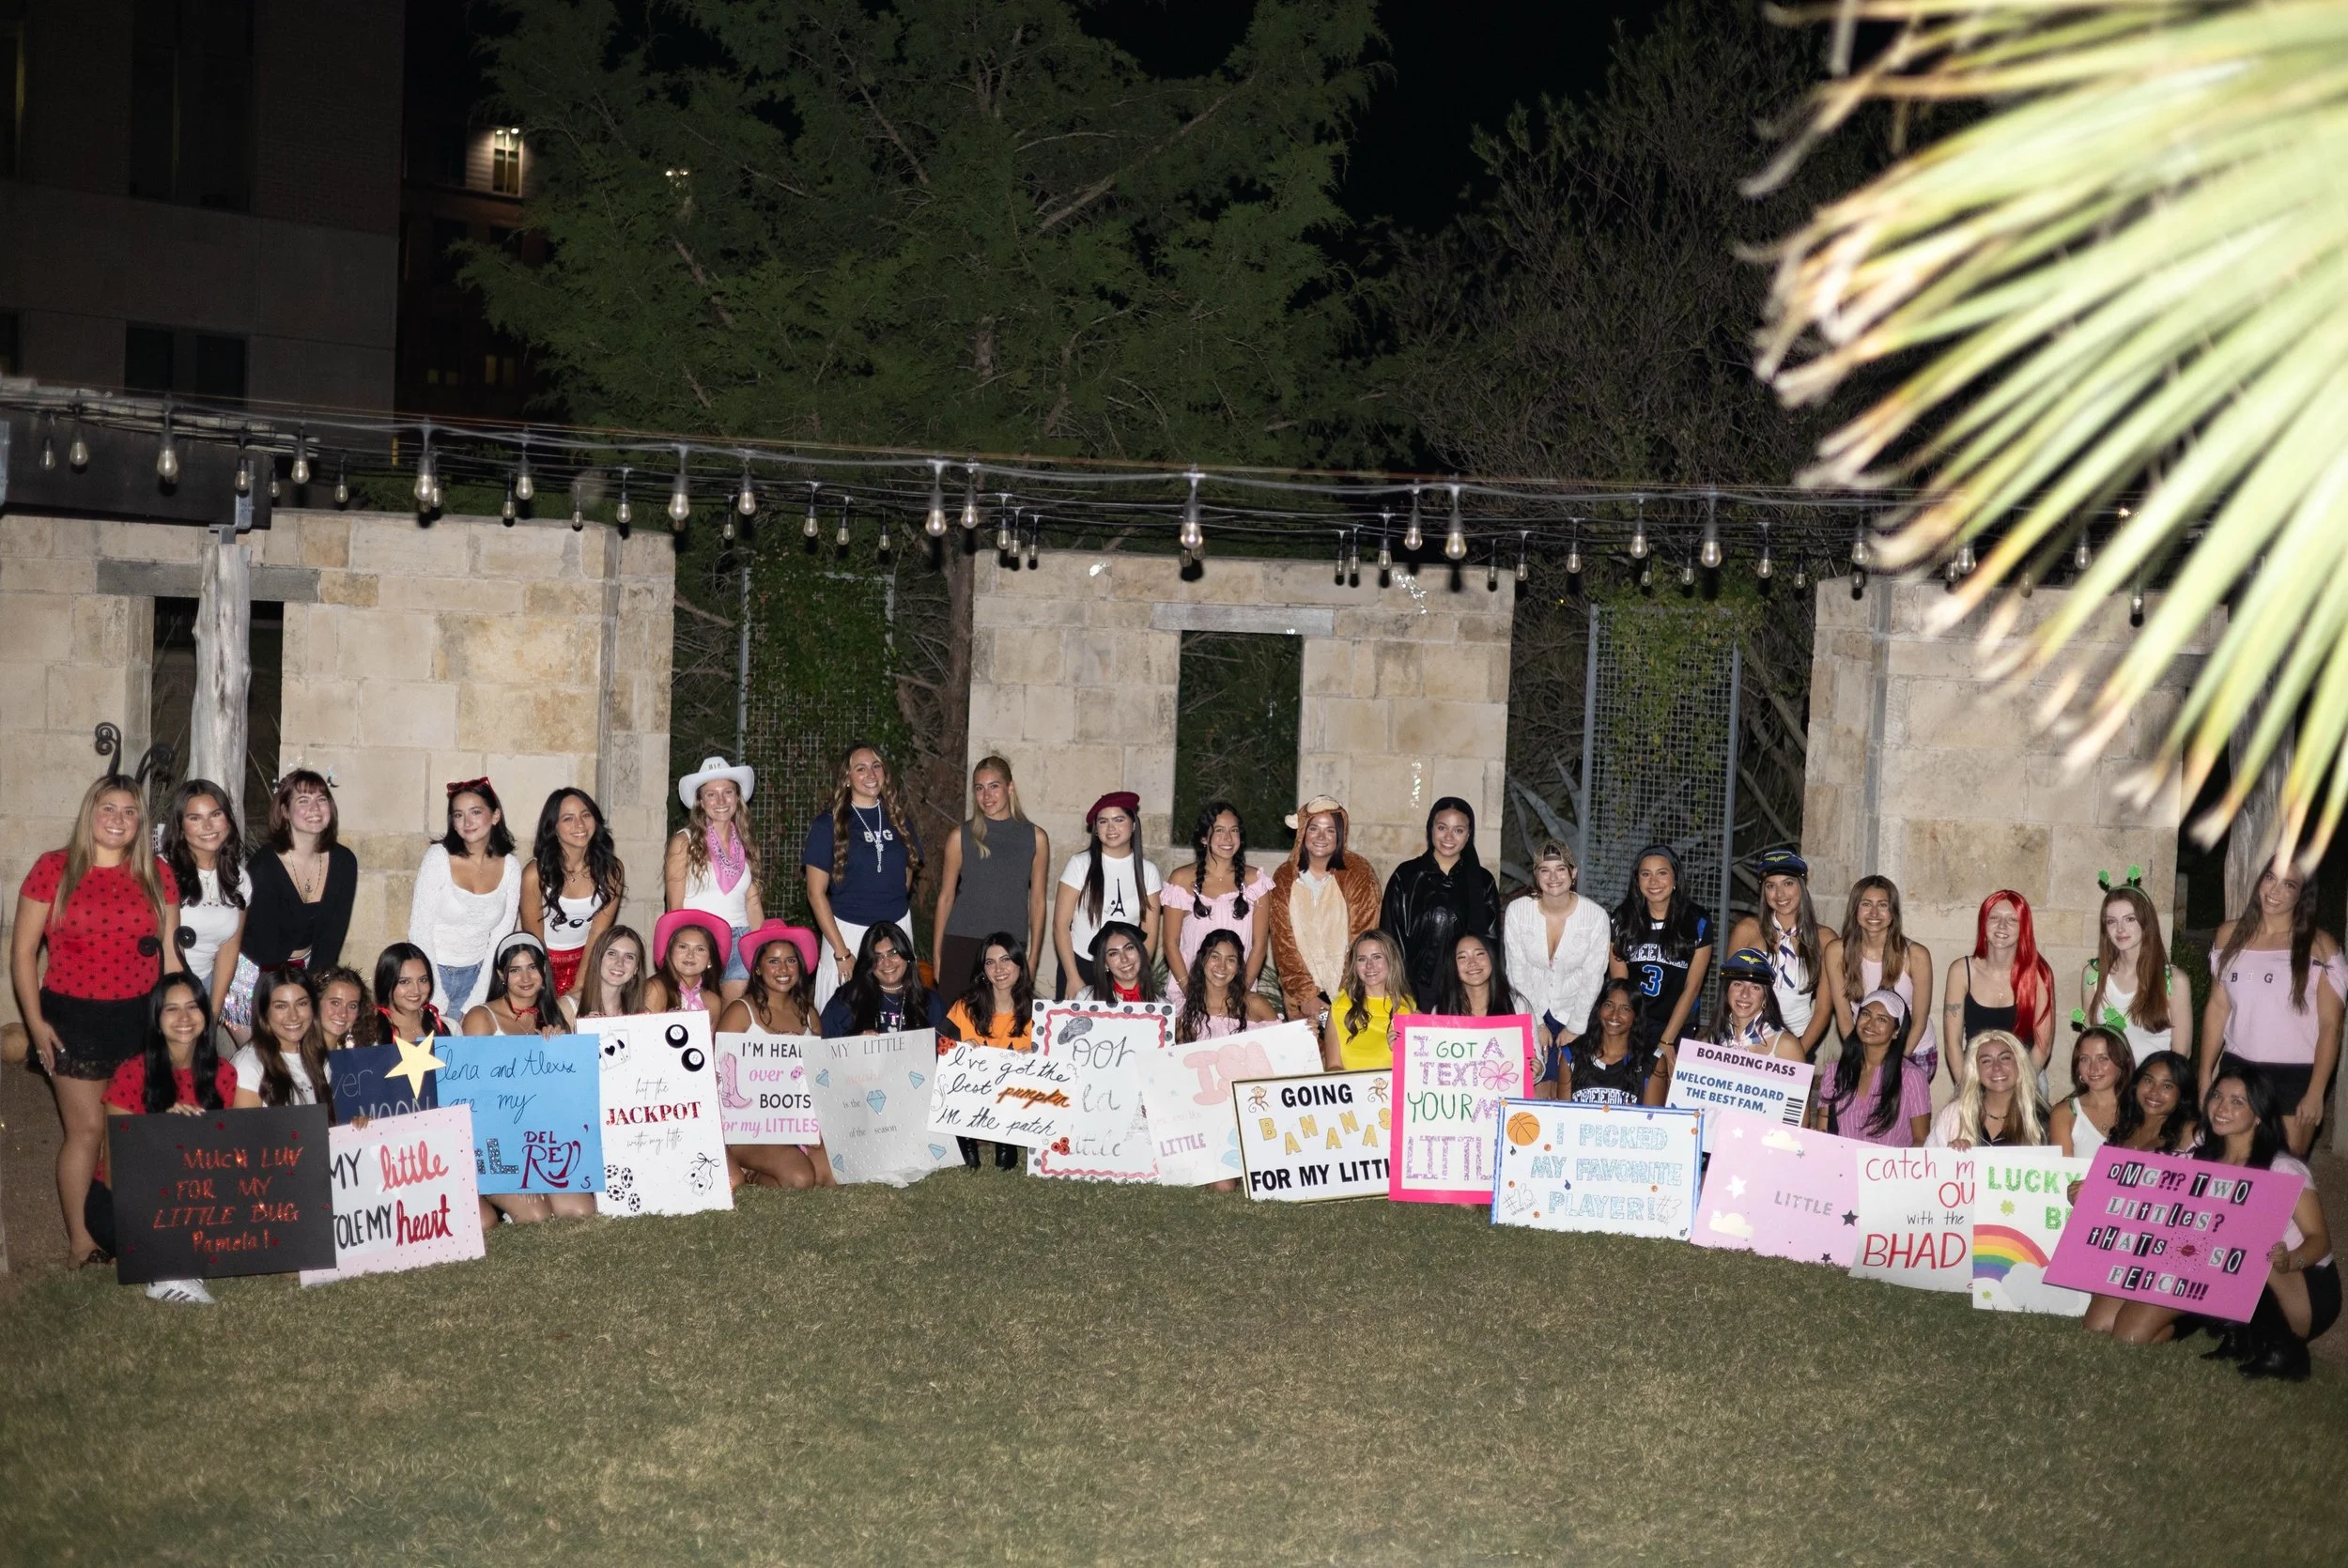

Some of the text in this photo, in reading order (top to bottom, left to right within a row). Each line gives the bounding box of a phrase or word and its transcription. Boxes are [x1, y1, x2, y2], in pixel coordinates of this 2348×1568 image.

[1640, 964, 1663, 997] 3
[742, 1041, 764, 1057] I'M
[830, 1037, 905, 1060] MY LITTLE
[1413, 1035, 1505, 1059] I GOT A
[490, 1057, 517, 1079] and
[749, 1068, 784, 1083] over
[995, 1059, 1036, 1084] got
[1037, 1061, 1071, 1083] the
[1419, 1060, 1486, 1087] TEXT
[1697, 1047, 1796, 1077] BOARDING PASS
[947, 1073, 1071, 1110] best pumpkin
[1281, 1084, 1353, 1108] GOING
[1676, 1070, 1784, 1101] WELCOME ABOARD
[497, 1094, 536, 1124] my
[606, 1101, 702, 1126] JACKPOT
[760, 1094, 811, 1108] BOOTS
[1408, 1091, 1499, 1123] YOUR M
[1686, 1086, 1767, 1114] THE BEST FAM,
[740, 1122, 762, 1138] my
[765, 1118, 819, 1132] LITTLES
[873, 1125, 897, 1134] season
[935, 1105, 1057, 1136] in the patch
[523, 1130, 557, 1144] DEL
[1159, 1132, 1207, 1158] LITTLE
[1556, 1122, 1668, 1151] I PICKED
[261, 1146, 304, 1168] LUV
[379, 1141, 449, 1192] little
[474, 1138, 518, 1175] iL
[1406, 1135, 1494, 1181] LITTL
[1865, 1149, 1974, 1182] catch m
[1250, 1168, 1292, 1192] FOR
[1299, 1164, 1330, 1187] MY
[1530, 1156, 1684, 1187] MY FAVORITE
[176, 1176, 272, 1201] FOR MY
[1939, 1182, 1974, 1208] OU
[2188, 1172, 2253, 1206] TWO
[152, 1201, 300, 1229] LITTLE BUG
[1548, 1191, 1656, 1222] PLAYER!
[1774, 1190, 1833, 1217] LITTLE
[332, 1193, 454, 1250] OLE MY heart
[1907, 1211, 1965, 1225] with the
[1862, 1232, 1968, 1269] BHAD
[2208, 1246, 2247, 1275] SO
